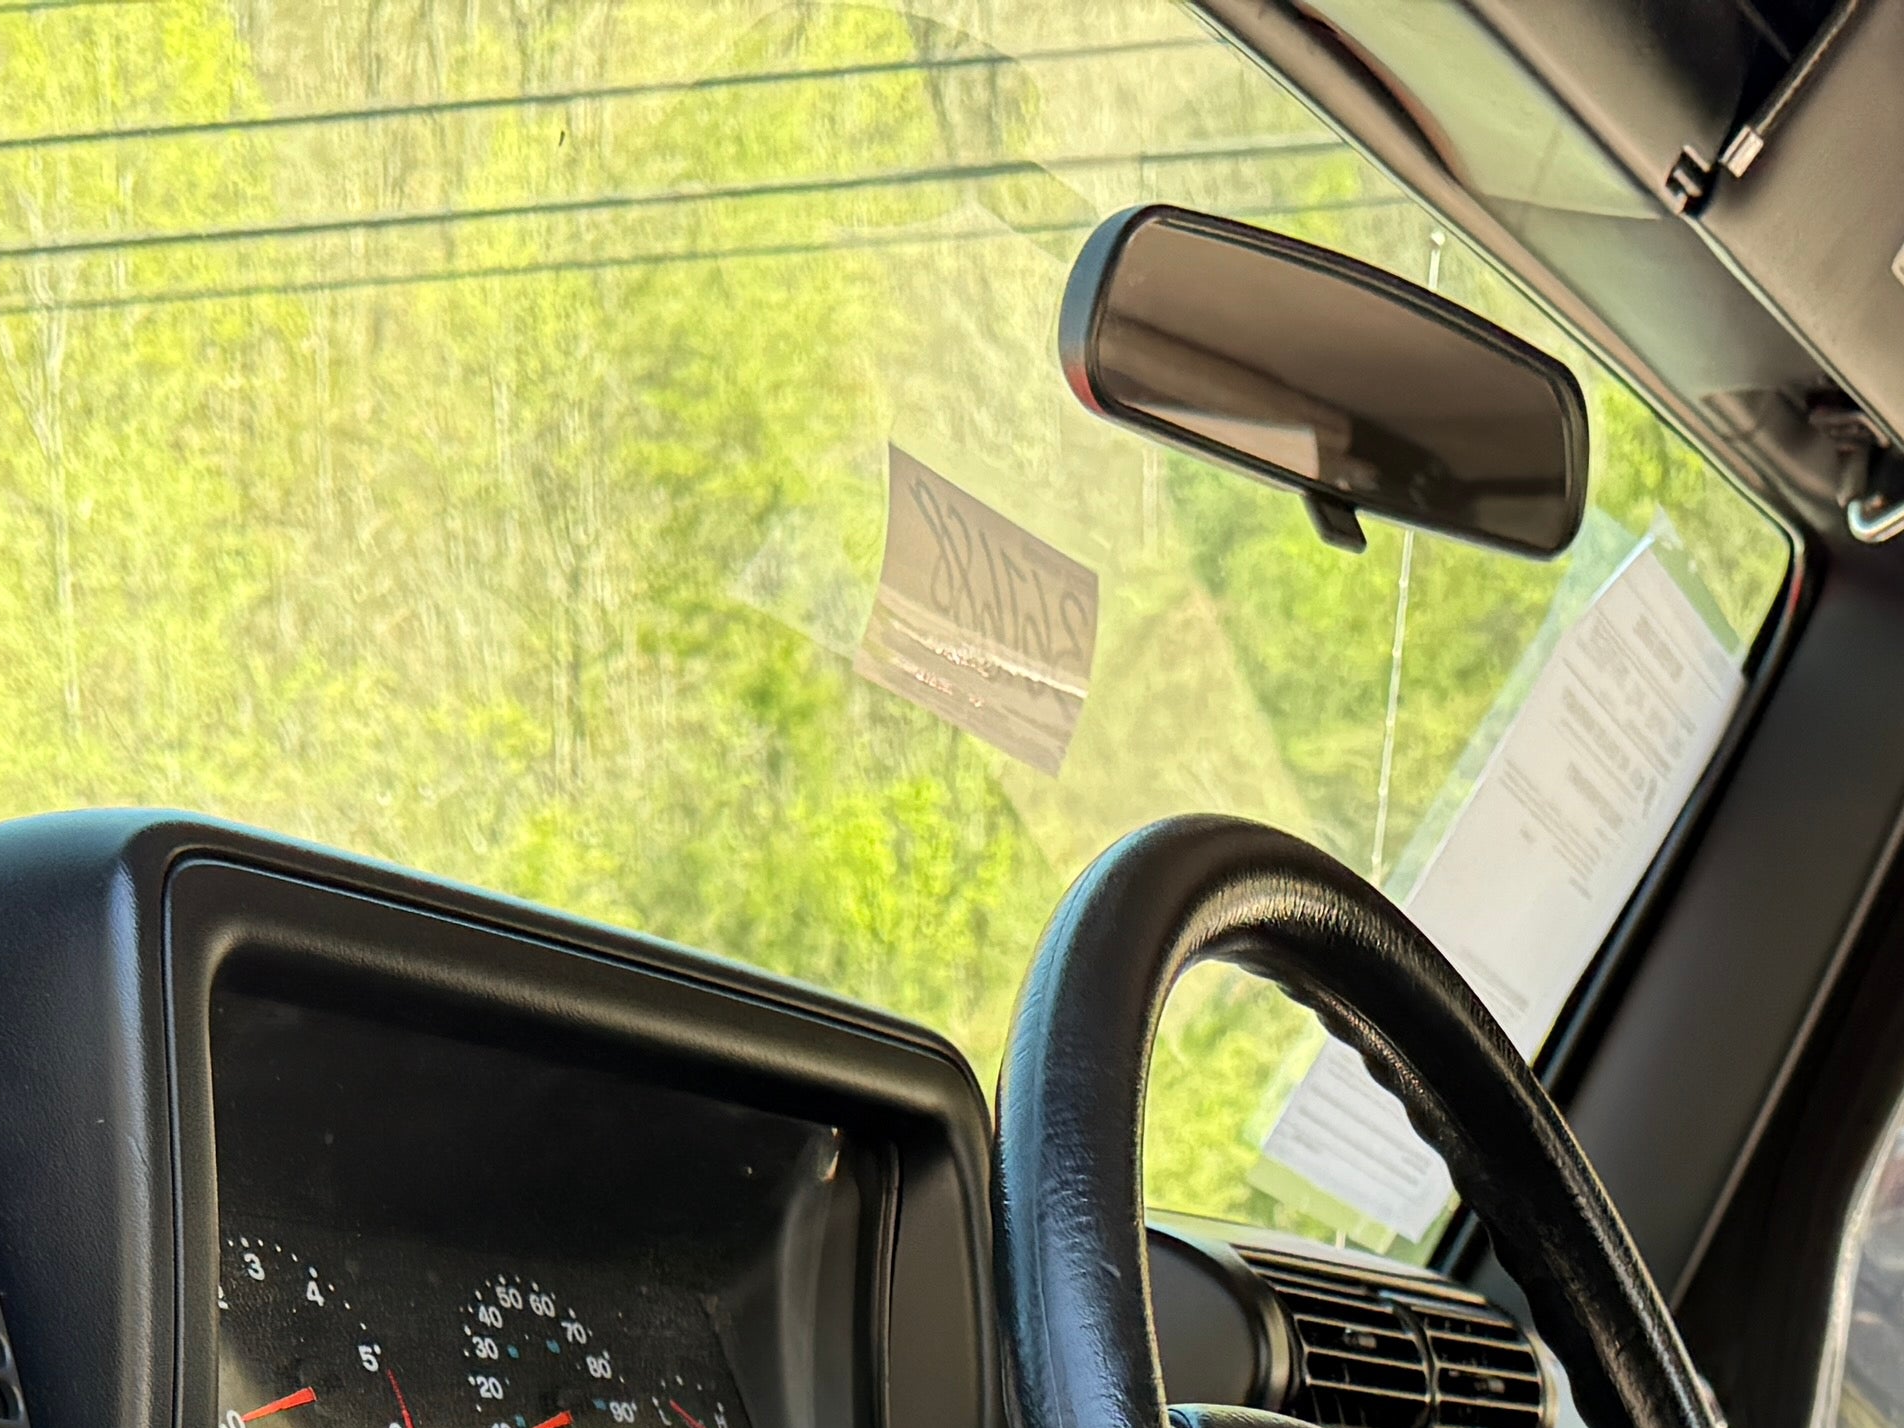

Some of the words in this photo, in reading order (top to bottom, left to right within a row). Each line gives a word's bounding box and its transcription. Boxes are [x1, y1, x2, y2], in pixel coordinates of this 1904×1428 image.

[244, 1253, 265, 1281] 3
[306, 1280, 324, 1307] 4
[496, 1286, 522, 1309] 50
[529, 1293, 555, 1317] 60
[478, 1304, 502, 1328] 40
[560, 1321, 586, 1344] 70
[358, 1345, 378, 1372] 5
[472, 1336, 498, 1360] 30
[586, 1355, 612, 1379] 80
[476, 1376, 503, 1399] 20
[609, 1402, 634, 1423] 90
